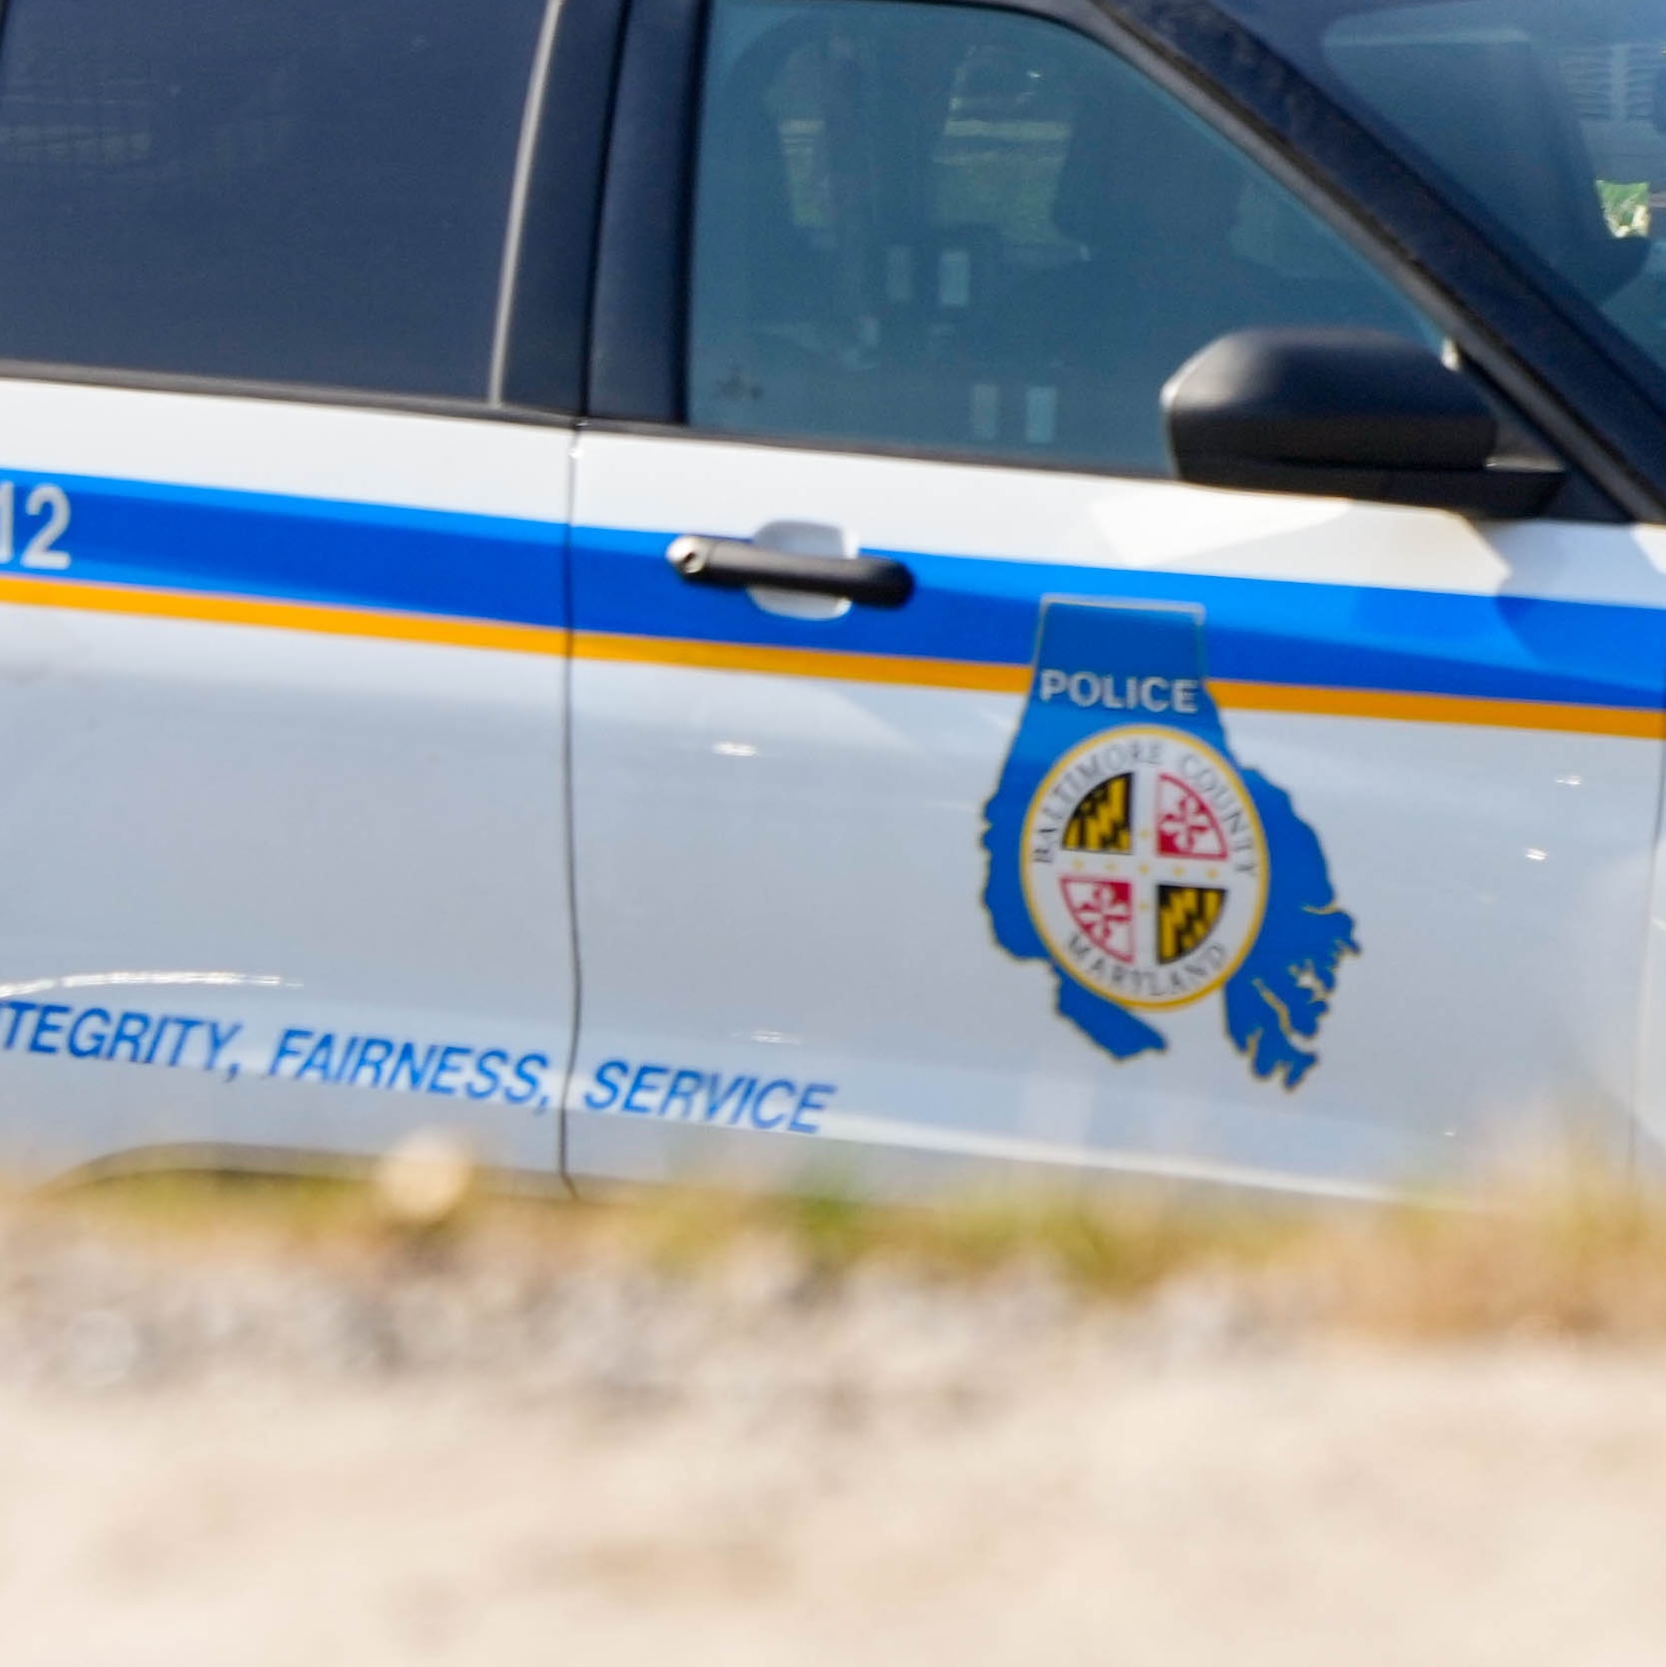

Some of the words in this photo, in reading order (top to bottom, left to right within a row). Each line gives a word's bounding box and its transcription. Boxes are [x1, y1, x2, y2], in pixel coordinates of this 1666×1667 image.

[1040, 669, 1200, 714] POLICE
[1181, 752, 1259, 877] COUNTY
[1067, 932, 1227, 997] MARYLAND
[266, 1027, 552, 1113] FAIRNESS,
[583, 1058, 839, 1135] SERVICE
